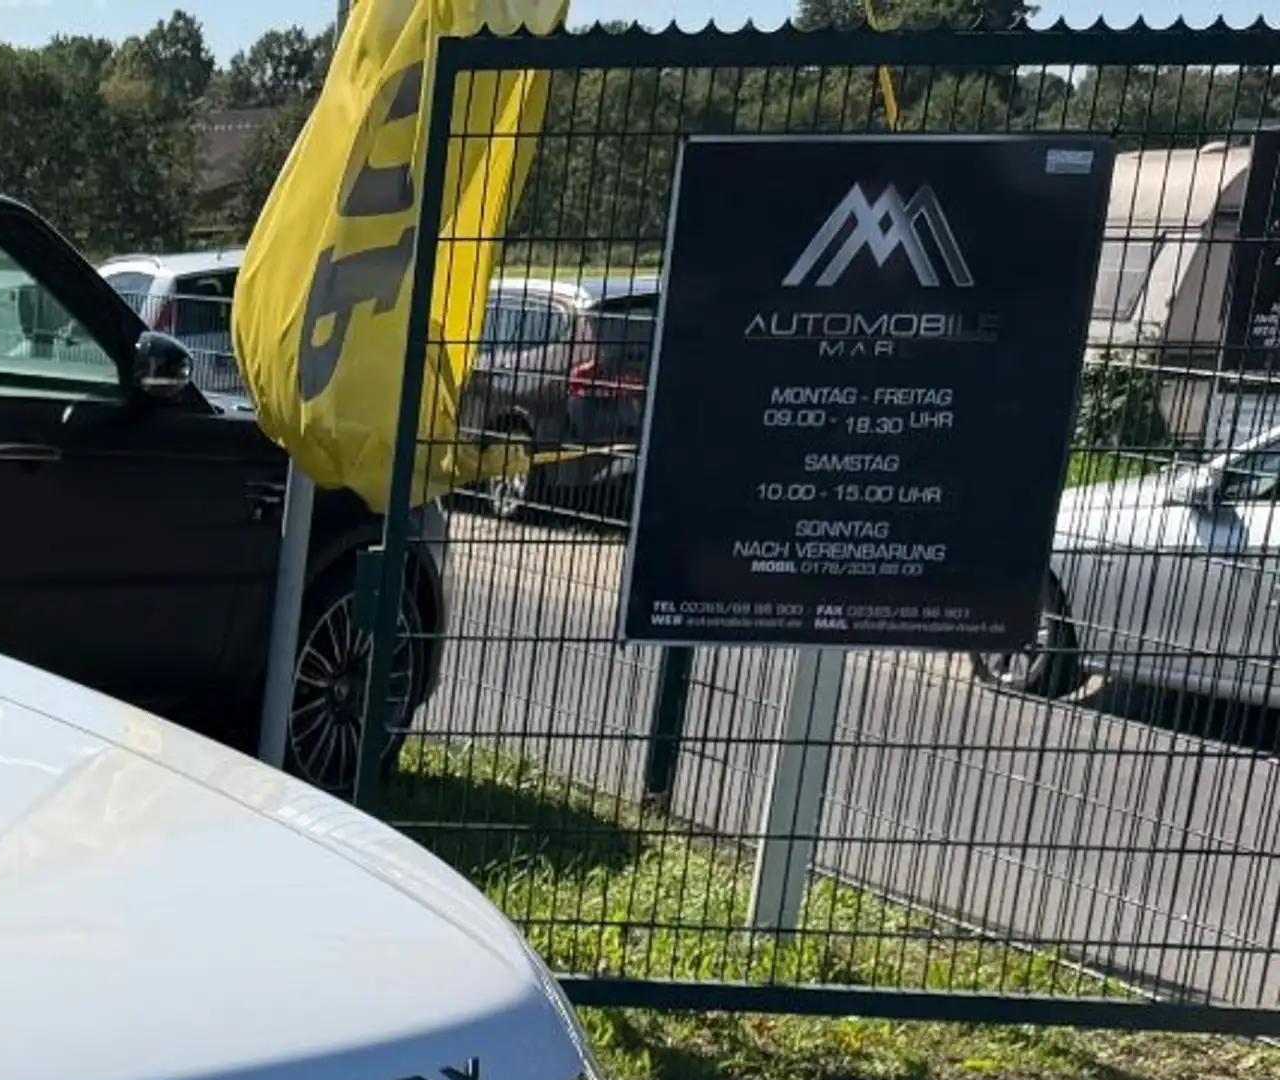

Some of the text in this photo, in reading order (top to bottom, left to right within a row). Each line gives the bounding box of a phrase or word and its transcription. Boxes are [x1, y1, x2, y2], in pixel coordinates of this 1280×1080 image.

[771, 387, 857, 404] MONTAG
[874, 388, 954, 405] FREITAG
[764, 409, 825, 427] 09.00
[845, 416, 903, 433] 18.30
[910, 411, 954, 429] UHR
[804, 453, 900, 472] SAMSTAG
[757, 483, 816, 501] 10.00
[834, 484, 893, 502] 15.00
[898, 486, 943, 503] UHR
[795, 519, 890, 538] SONNTAG
[732, 540, 947, 561] NACH VEREINBARUNG
[751, 560, 796, 574] MOBIL
[653, 601, 677, 613] TEL
[816, 605, 843, 616] FAX
